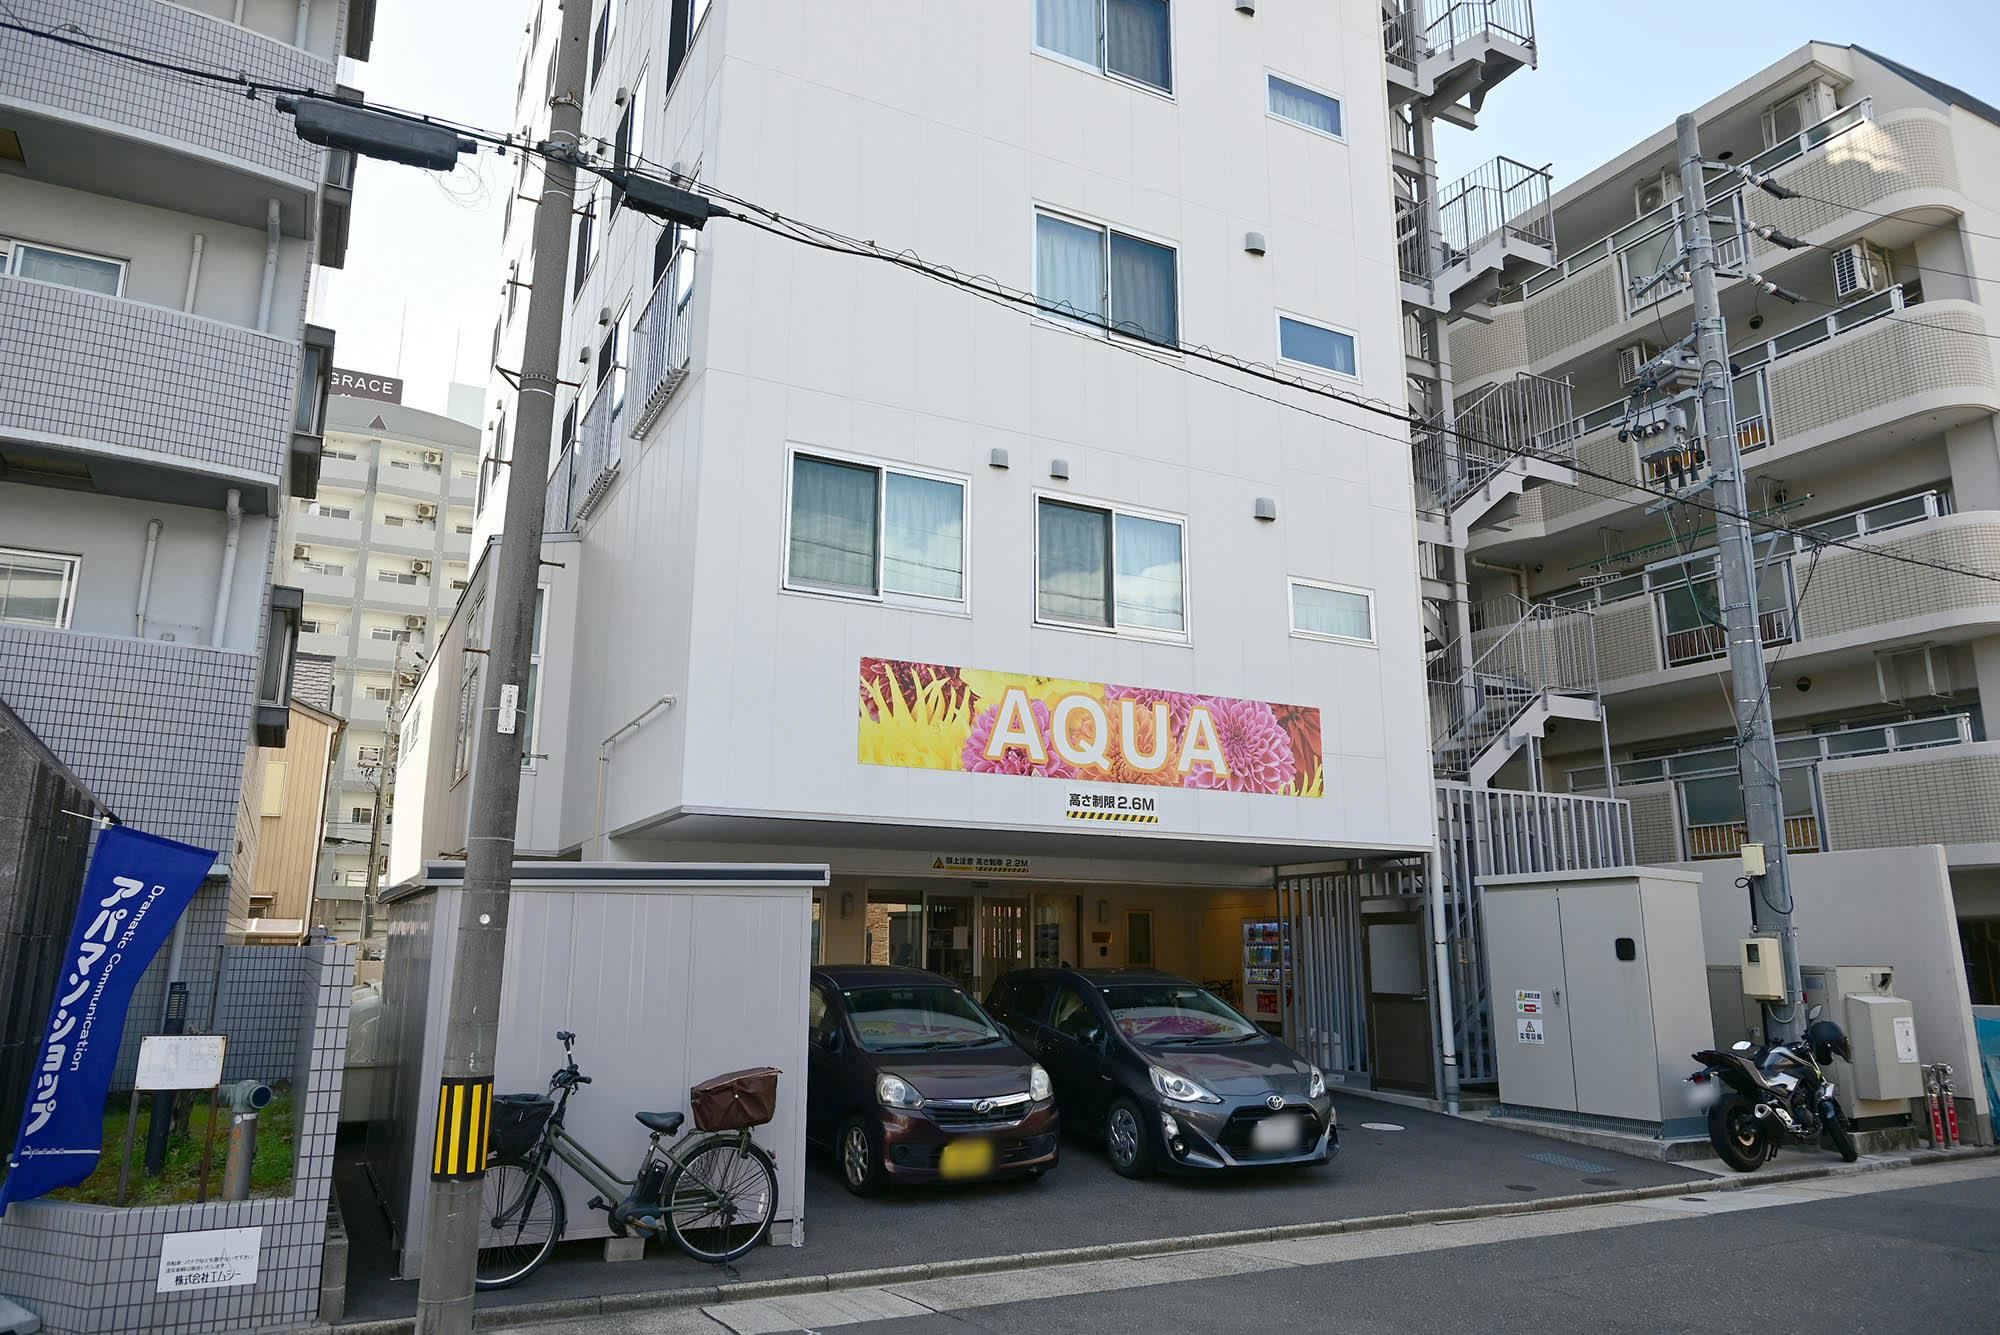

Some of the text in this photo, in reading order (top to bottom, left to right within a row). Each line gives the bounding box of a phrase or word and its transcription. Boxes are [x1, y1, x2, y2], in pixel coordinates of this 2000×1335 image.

[331, 372, 393, 395] GRACE
[985, 687, 1230, 777] AQUA
[1005, 859, 1028, 867] 2.2M
[25, 875, 145, 1137] アパマンショップ
[70, 885, 166, 1071] Dramatic Communication
[175, 1269, 241, 1286] 株式会社エムシー
